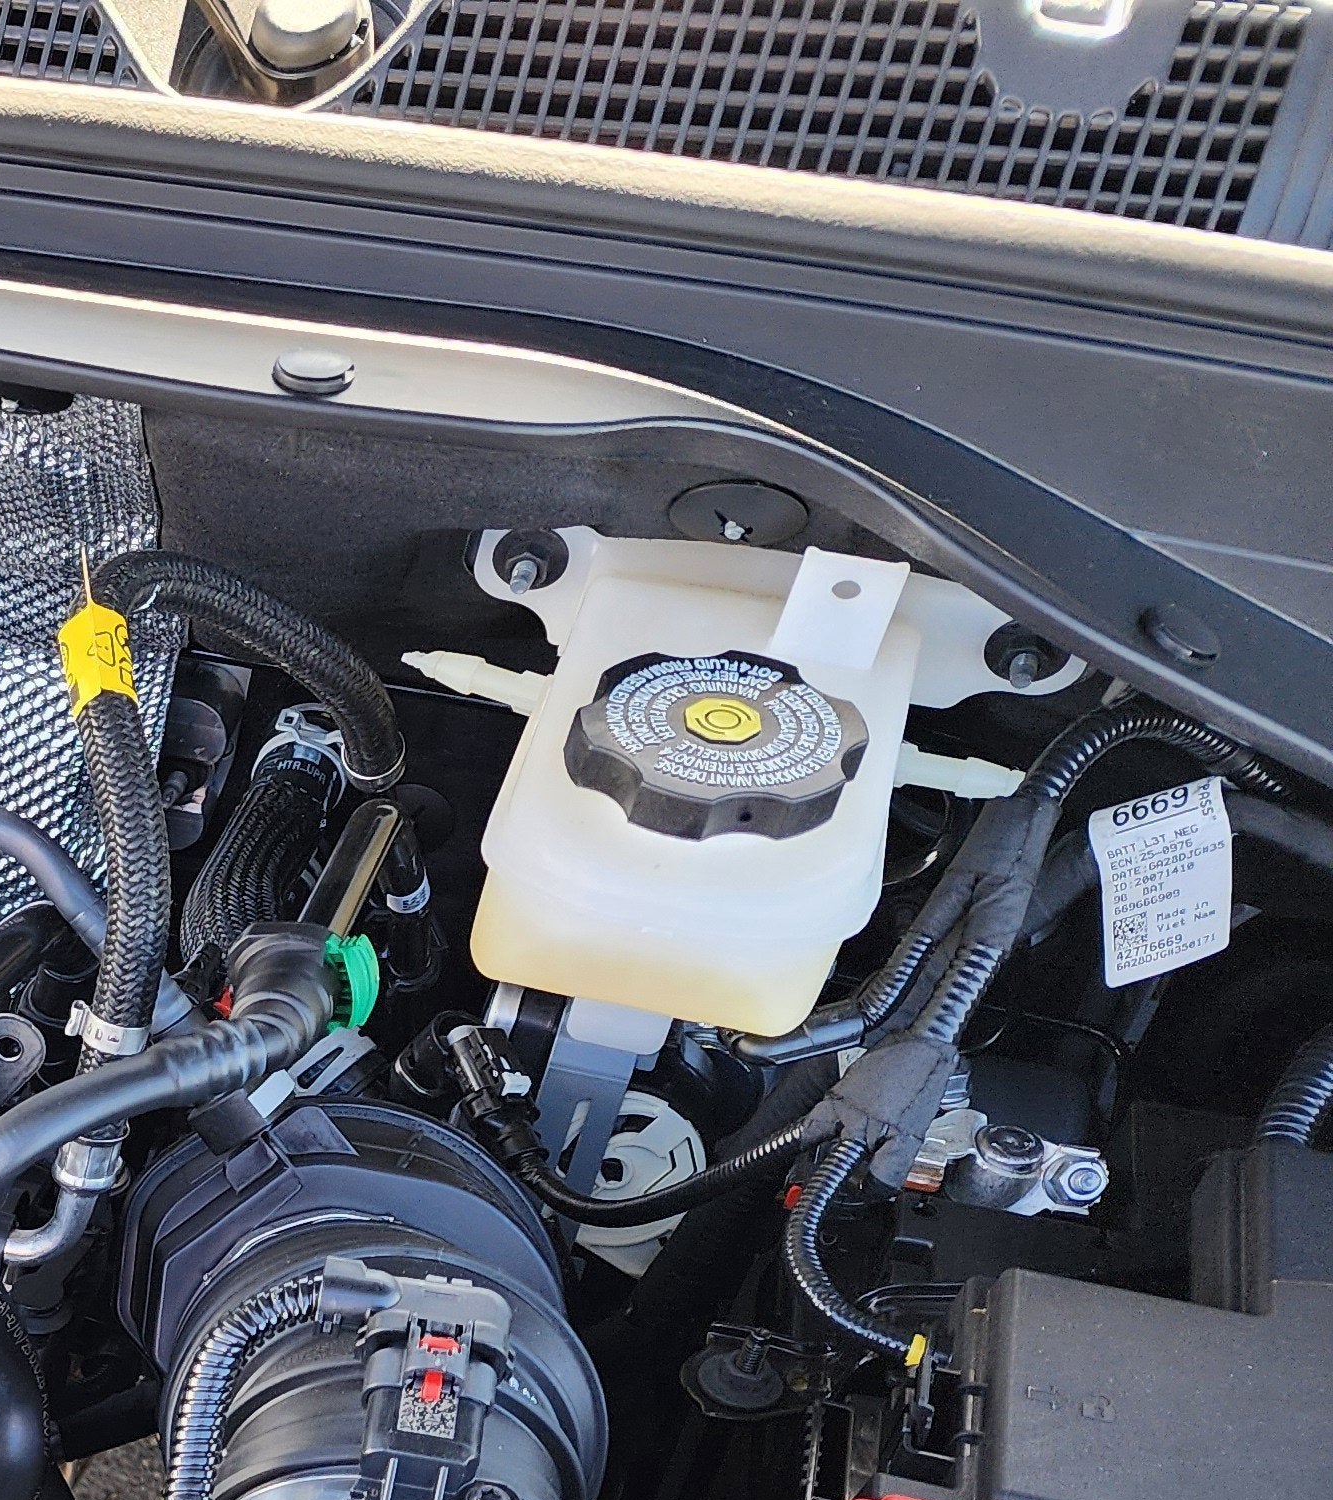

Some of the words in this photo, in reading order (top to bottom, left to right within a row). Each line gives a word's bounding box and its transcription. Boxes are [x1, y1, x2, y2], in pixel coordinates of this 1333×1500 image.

[691, 659, 740, 672] FLUID
[748, 664, 786, 683] DOT
[738, 674, 775, 692] CAP
[1112, 786, 1189, 826] 6669
[1156, 908, 1186, 922] Made
[1194, 901, 1209, 911] in
[1157, 919, 1186, 932] Viet
[1193, 910, 1217, 921] Nam
[1116, 934, 1183, 961] 42776669
